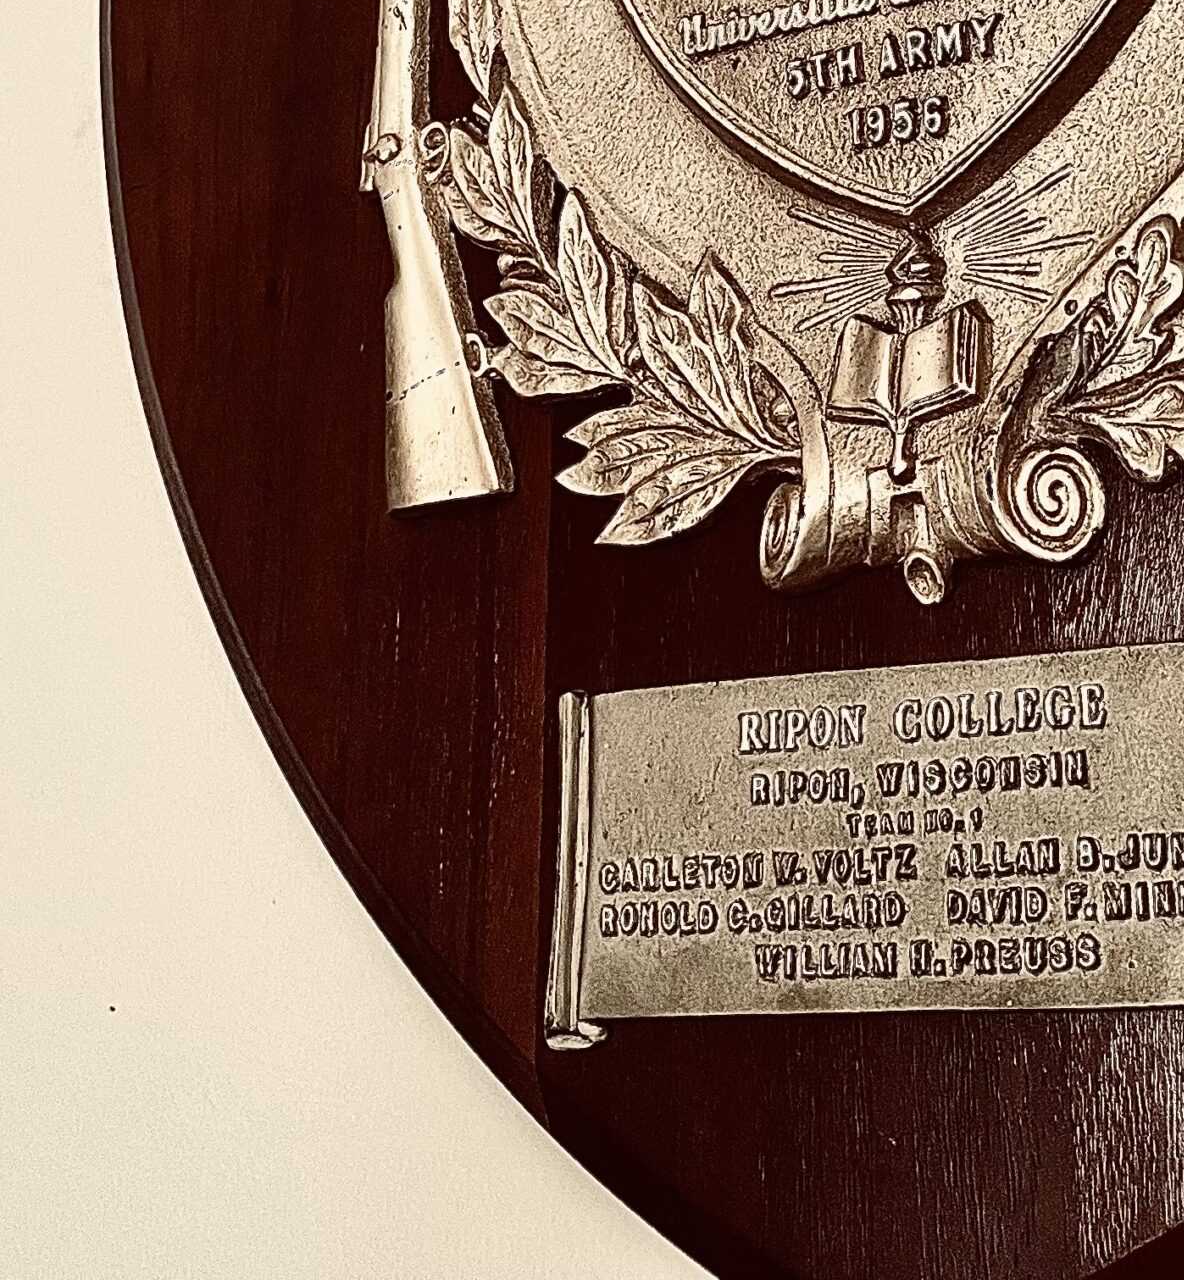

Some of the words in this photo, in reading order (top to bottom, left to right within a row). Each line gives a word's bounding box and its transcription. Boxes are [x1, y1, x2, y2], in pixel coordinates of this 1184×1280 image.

[783, 42, 864, 99] 5TH
[877, 13, 1001, 78] ARMY
[845, 95, 952, 152] 1956
[737, 704, 867, 756] RIPON
[893, 683, 1108, 744] COLLEGE
[750, 767, 865, 810] RIPON,
[876, 749, 1091, 798] WISCONSIN
[846, 811, 915, 839] TEAM
[600, 851, 765, 895] CARLETON
[946, 836, 1062, 879] ALLAN
[946, 885, 1049, 924] DAVID
[754, 941, 899, 982] WILLIAM
